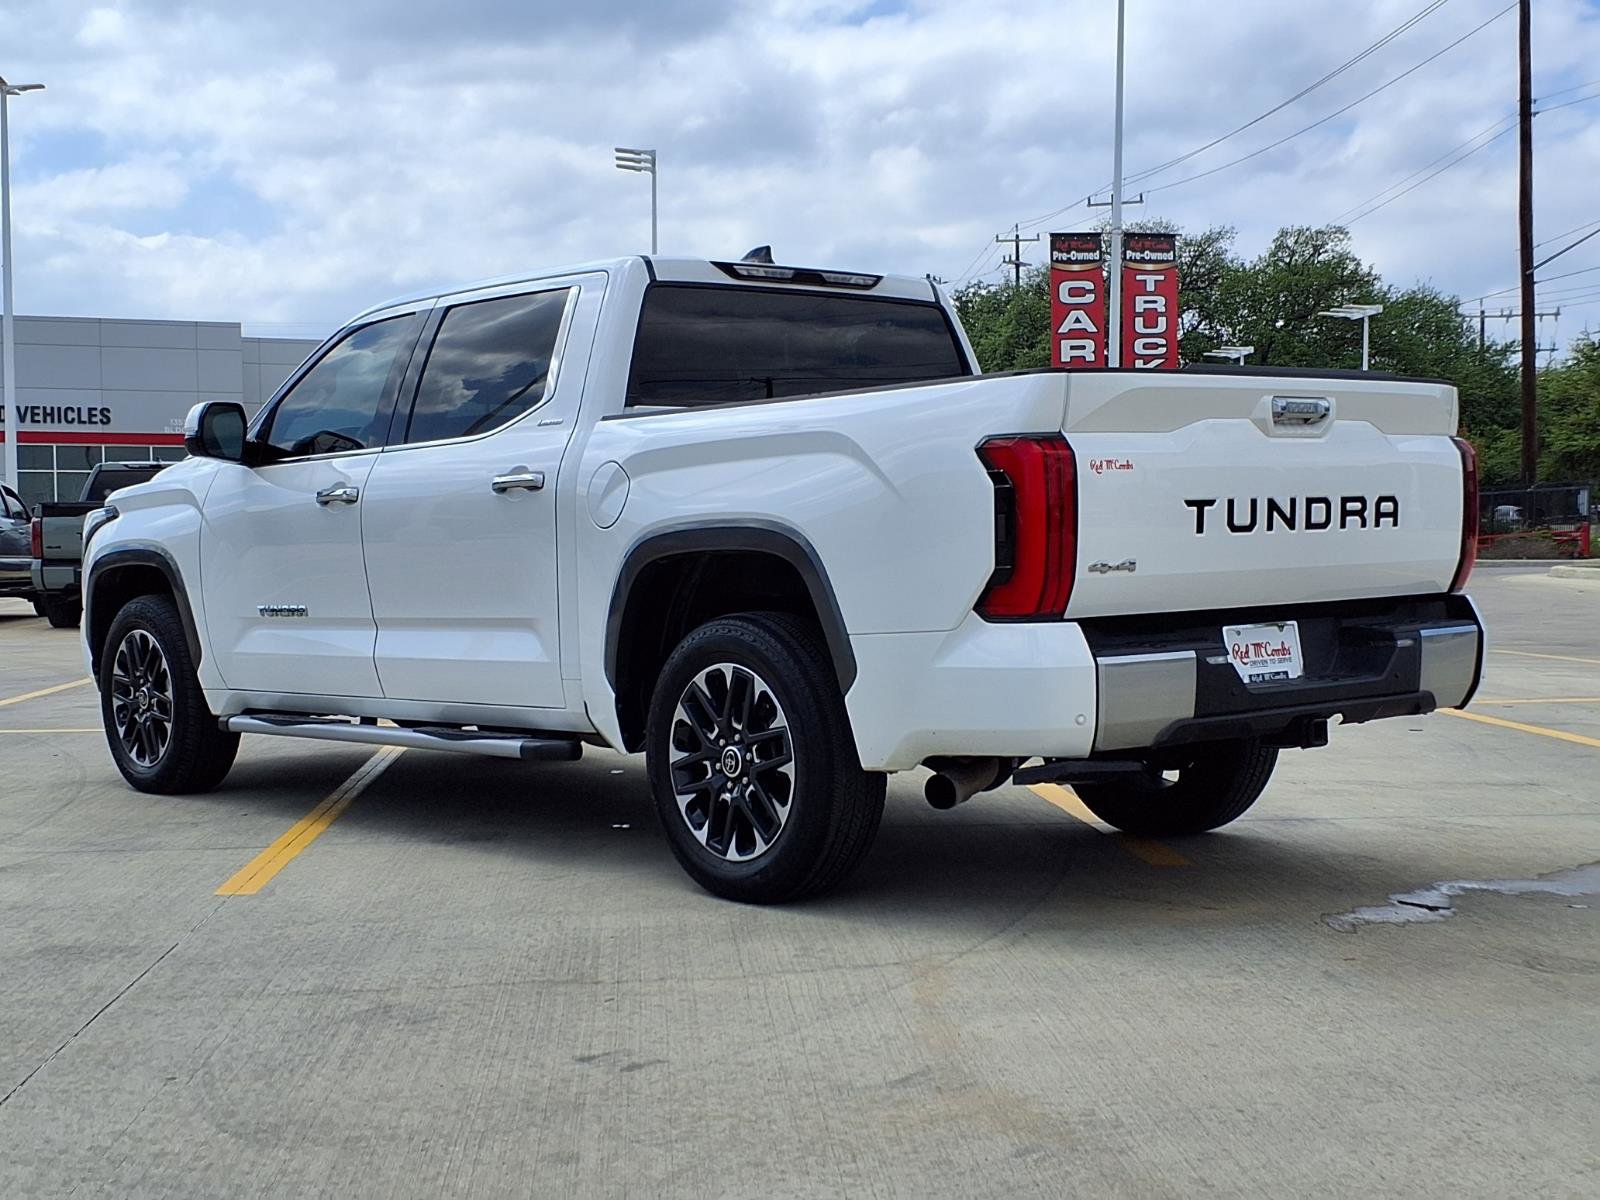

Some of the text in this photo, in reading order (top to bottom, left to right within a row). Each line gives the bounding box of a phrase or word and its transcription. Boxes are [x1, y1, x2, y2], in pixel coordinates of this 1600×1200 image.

[1052, 250, 1100, 261] Pre-Owned
[1126, 250, 1174, 260] Pre-Owned
[1057, 280, 1098, 363] CAR
[16, 405, 112, 425] VEHICLES
[1089, 459, 1103, 474] Red
[1183, 495, 1399, 535] TUNDRA
[1232, 641, 1291, 665] Red McCombs
